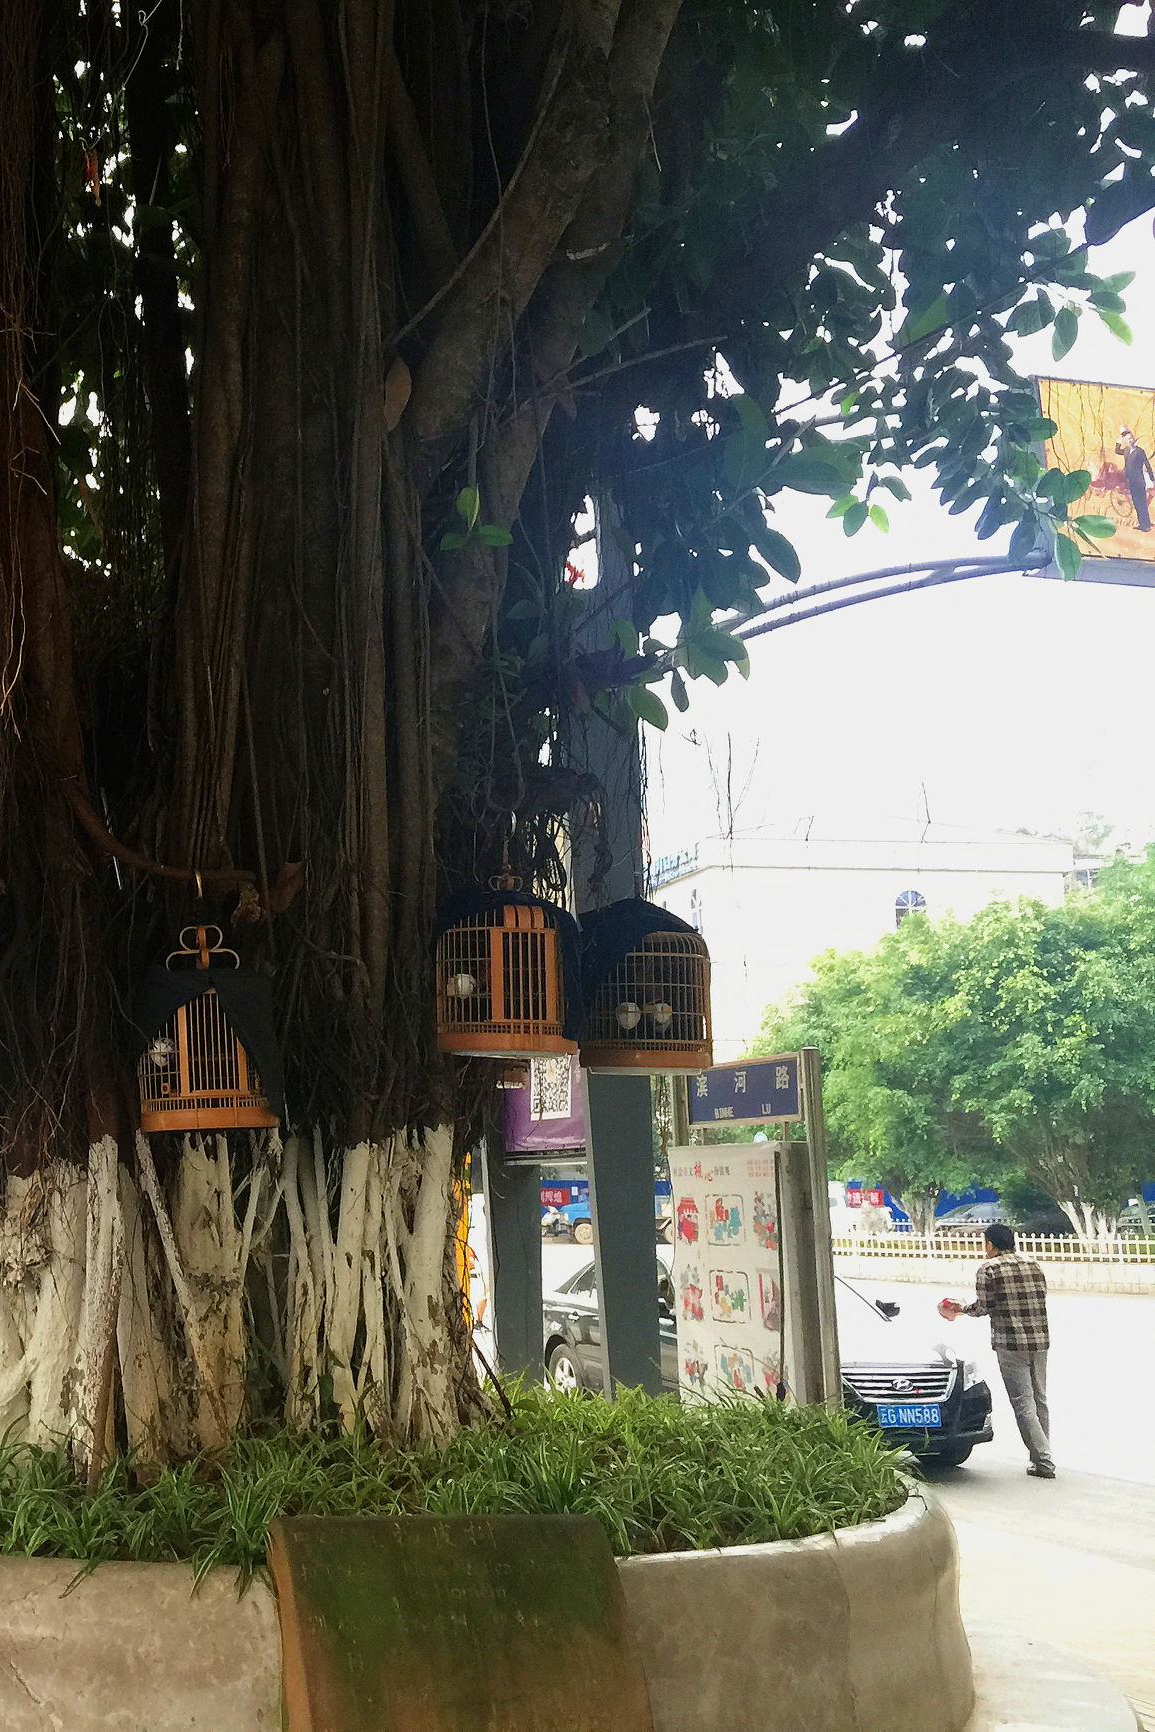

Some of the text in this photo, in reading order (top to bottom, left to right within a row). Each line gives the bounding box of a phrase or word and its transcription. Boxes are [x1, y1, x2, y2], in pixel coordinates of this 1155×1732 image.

[696, 1065, 789, 1097] 滨河路
[761, 1103, 772, 1115] LU
